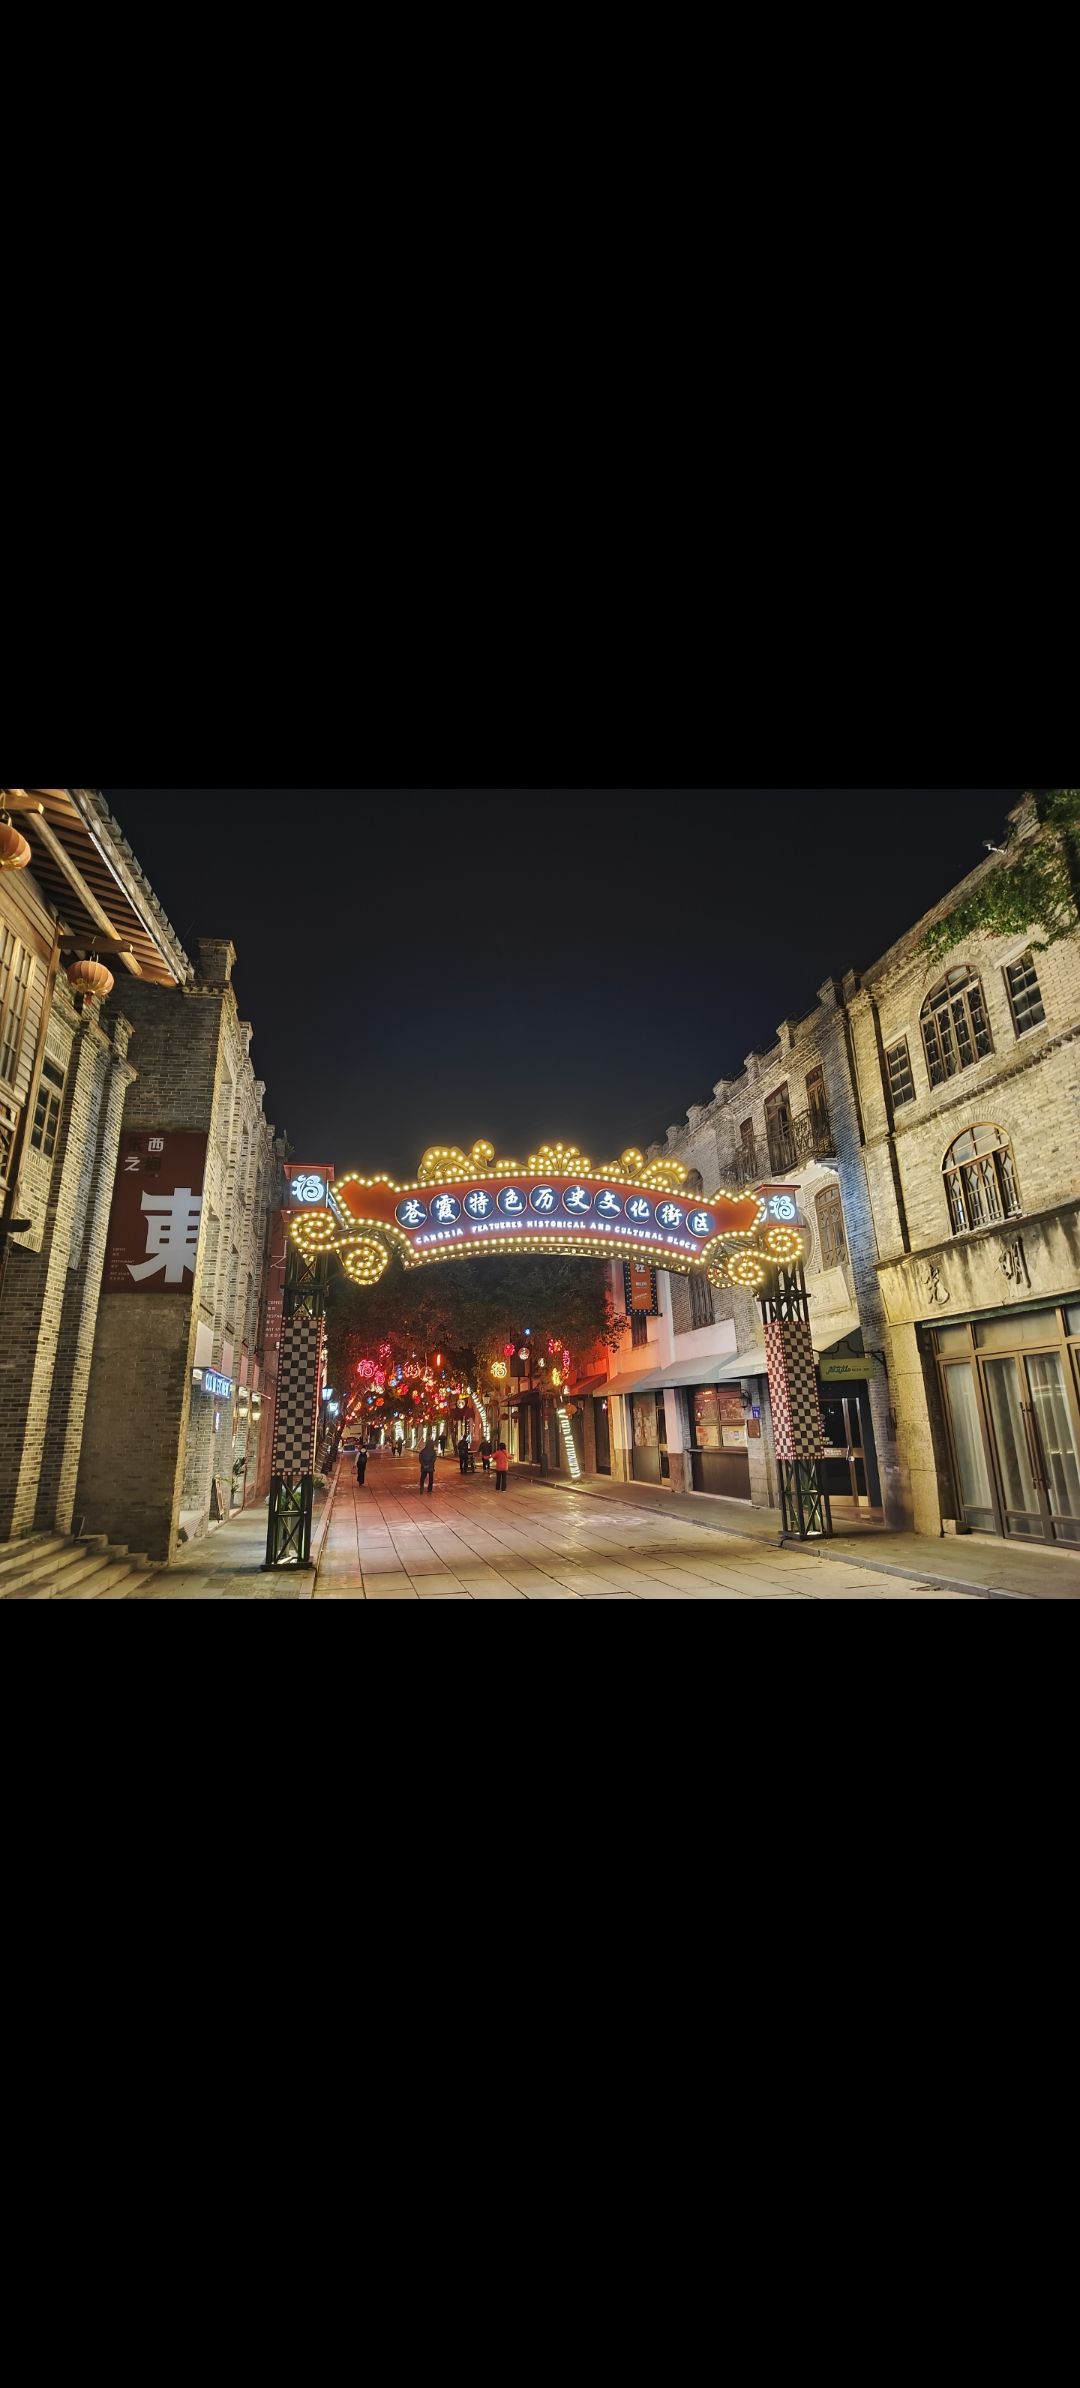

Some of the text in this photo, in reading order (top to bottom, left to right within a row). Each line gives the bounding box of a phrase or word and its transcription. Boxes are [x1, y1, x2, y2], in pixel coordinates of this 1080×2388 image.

[400, 1184, 711, 1233] 苍霞特色历史文化街区
[526, 1220, 587, 1231] HISTORICAL
[589, 1222, 612, 1233] AND
[614, 1225, 665, 1241] CULTURAL
[666, 1235, 699, 1252] BLOCK
